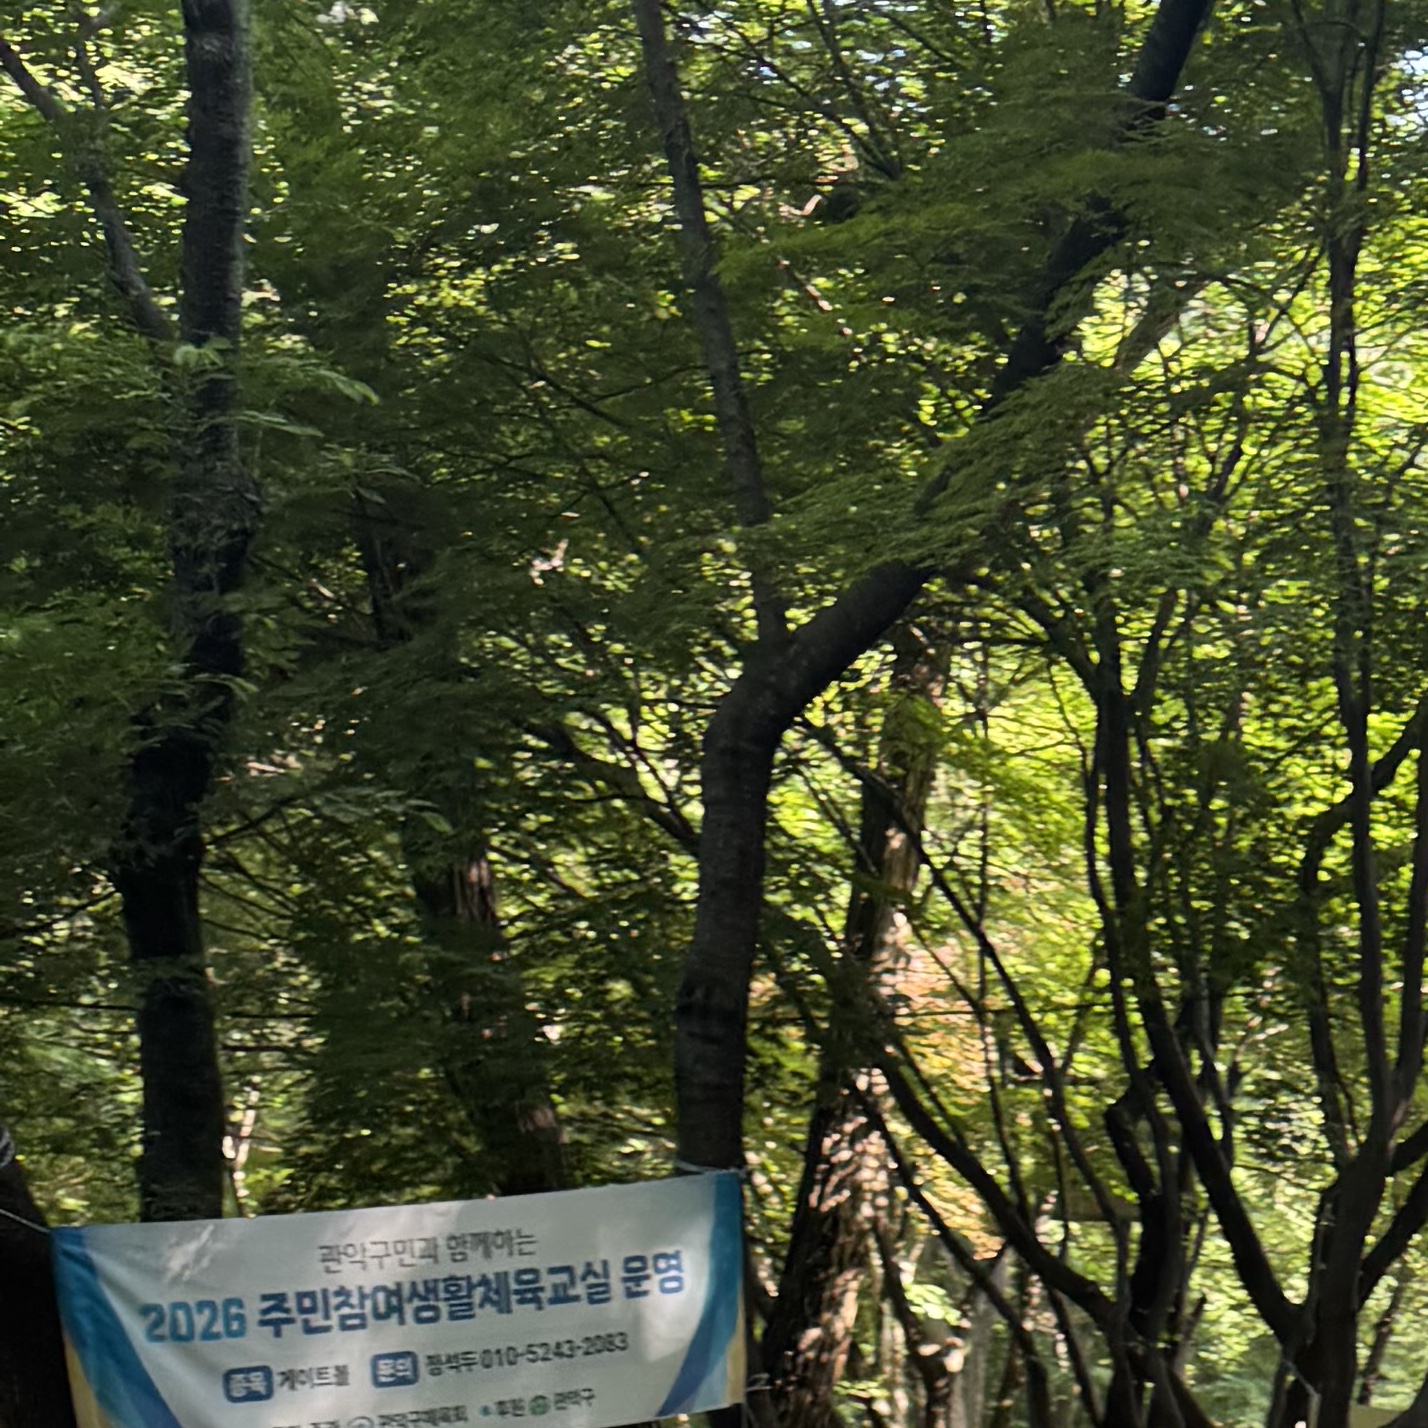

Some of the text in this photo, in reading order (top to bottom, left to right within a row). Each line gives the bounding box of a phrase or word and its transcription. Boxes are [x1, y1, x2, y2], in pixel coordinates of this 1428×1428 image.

[318, 1228, 538, 1275] 관악구민과 함께하는
[140, 1249, 684, 1343] 2026 주민참여생활체육교실 운영
[277, 1364, 350, 1392] 게이트볼
